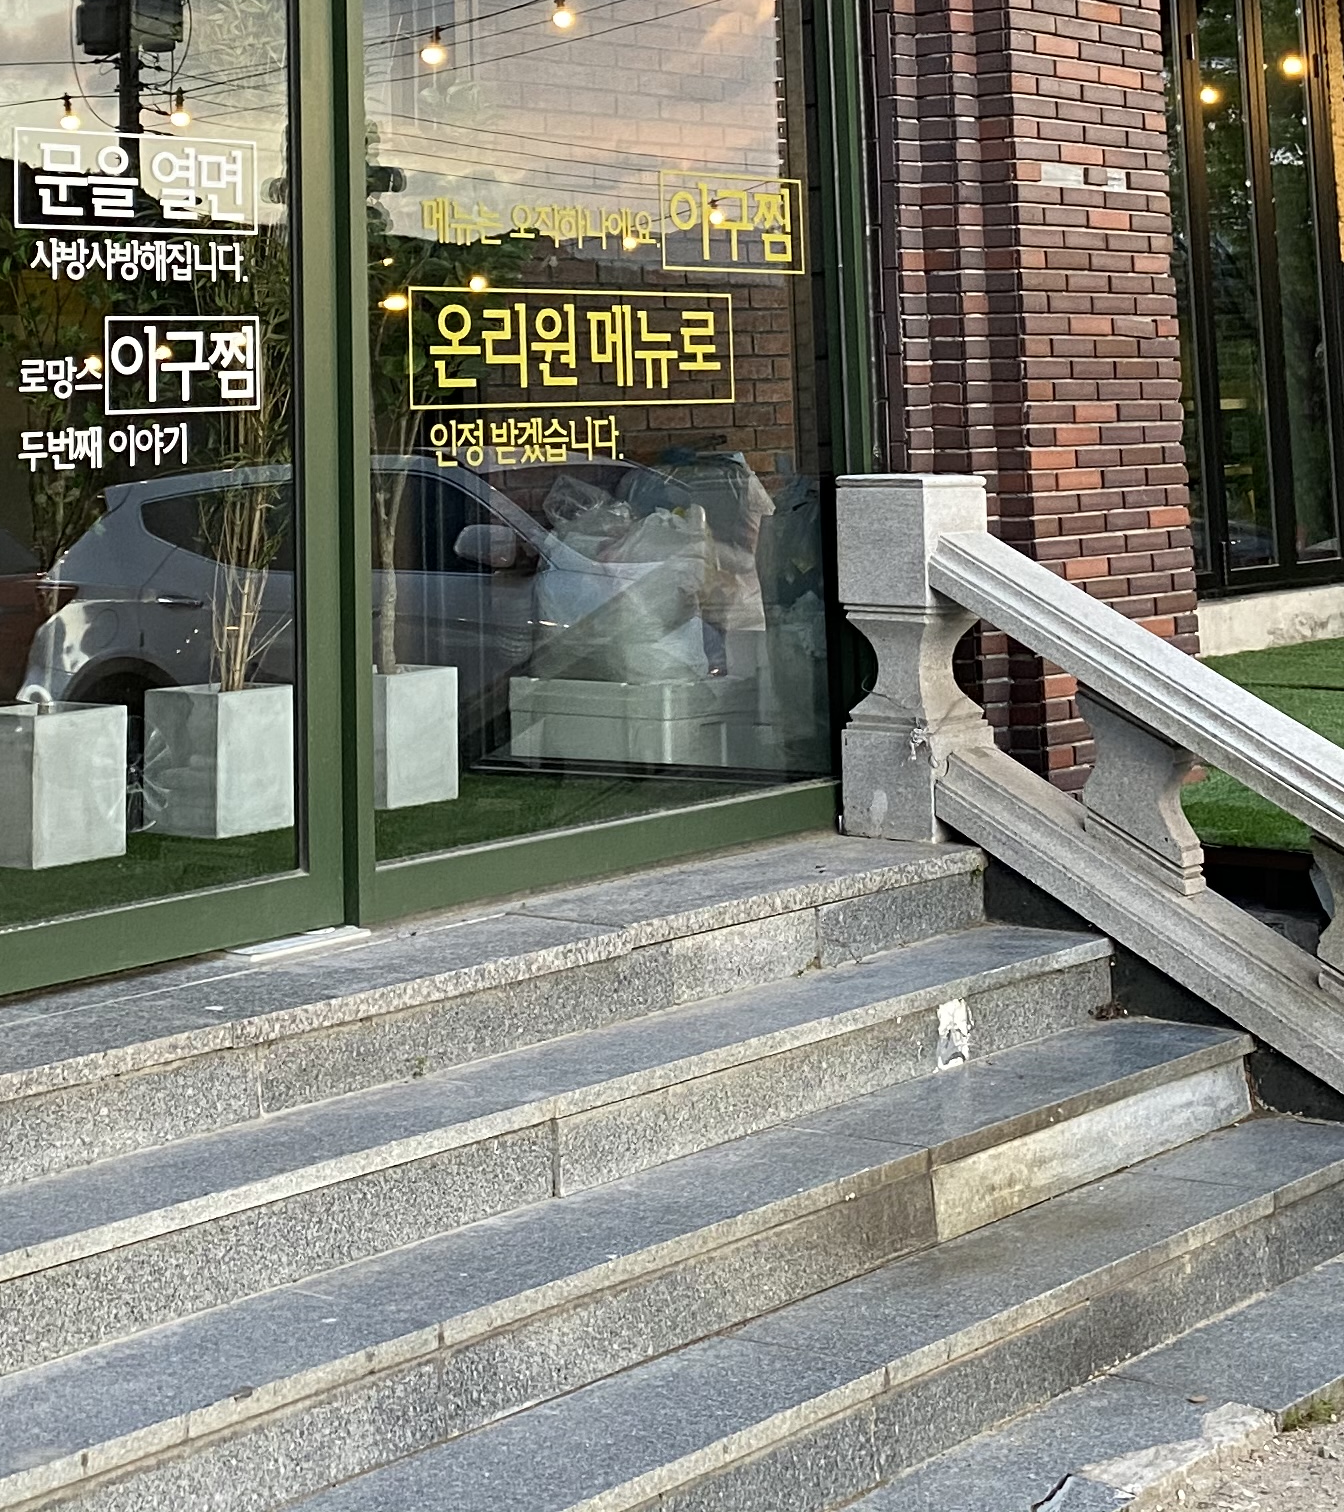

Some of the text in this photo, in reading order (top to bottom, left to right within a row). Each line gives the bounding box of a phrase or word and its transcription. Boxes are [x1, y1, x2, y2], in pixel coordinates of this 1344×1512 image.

[35, 143, 245, 221] 문을 열면
[31, 238, 248, 282] 샤방샤방해집니다.
[421, 197, 503, 246] 메뉴는
[669, 183, 792, 263] 아구찜
[18, 325, 255, 402] 로망스 아구찜
[429, 303, 721, 389] 온리원 메뉴로
[18, 423, 188, 472] 두번째 이야기
[430, 415, 624, 467] 인정 받겠습니다.
